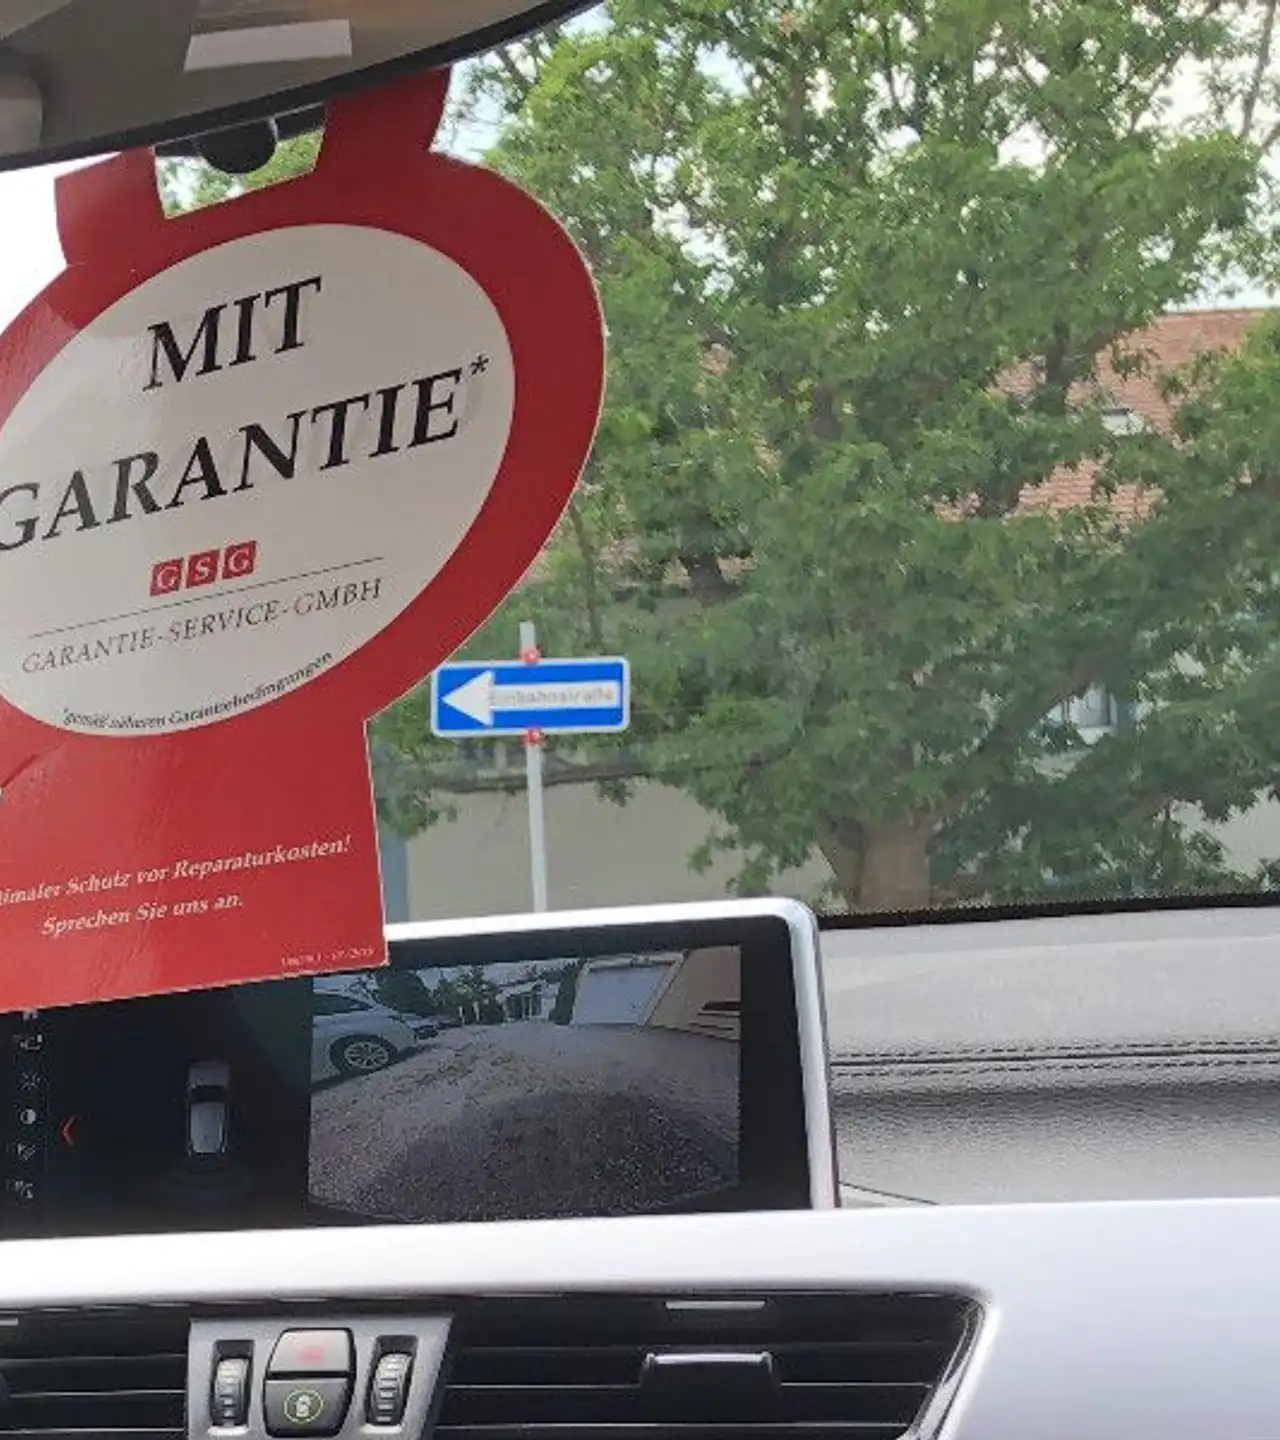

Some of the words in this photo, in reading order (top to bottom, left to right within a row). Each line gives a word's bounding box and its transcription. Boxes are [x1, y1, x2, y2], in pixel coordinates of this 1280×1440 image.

[143, 275, 322, 392] MIT
[151, 542, 256, 595] GSG
[22, 577, 382, 674] GARANTIE-SERVICE-GMBH
[168, 651, 333, 725] Garantiebedingungen
[66, 872, 130, 897] Schutz
[137, 865, 169, 884] vor
[173, 834, 351, 881] Reparaturkosten!
[42, 906, 130, 938] Sprechen
[137, 901, 166, 922] Sie
[174, 898, 209, 917] uns
[214, 892, 245, 911] an.
